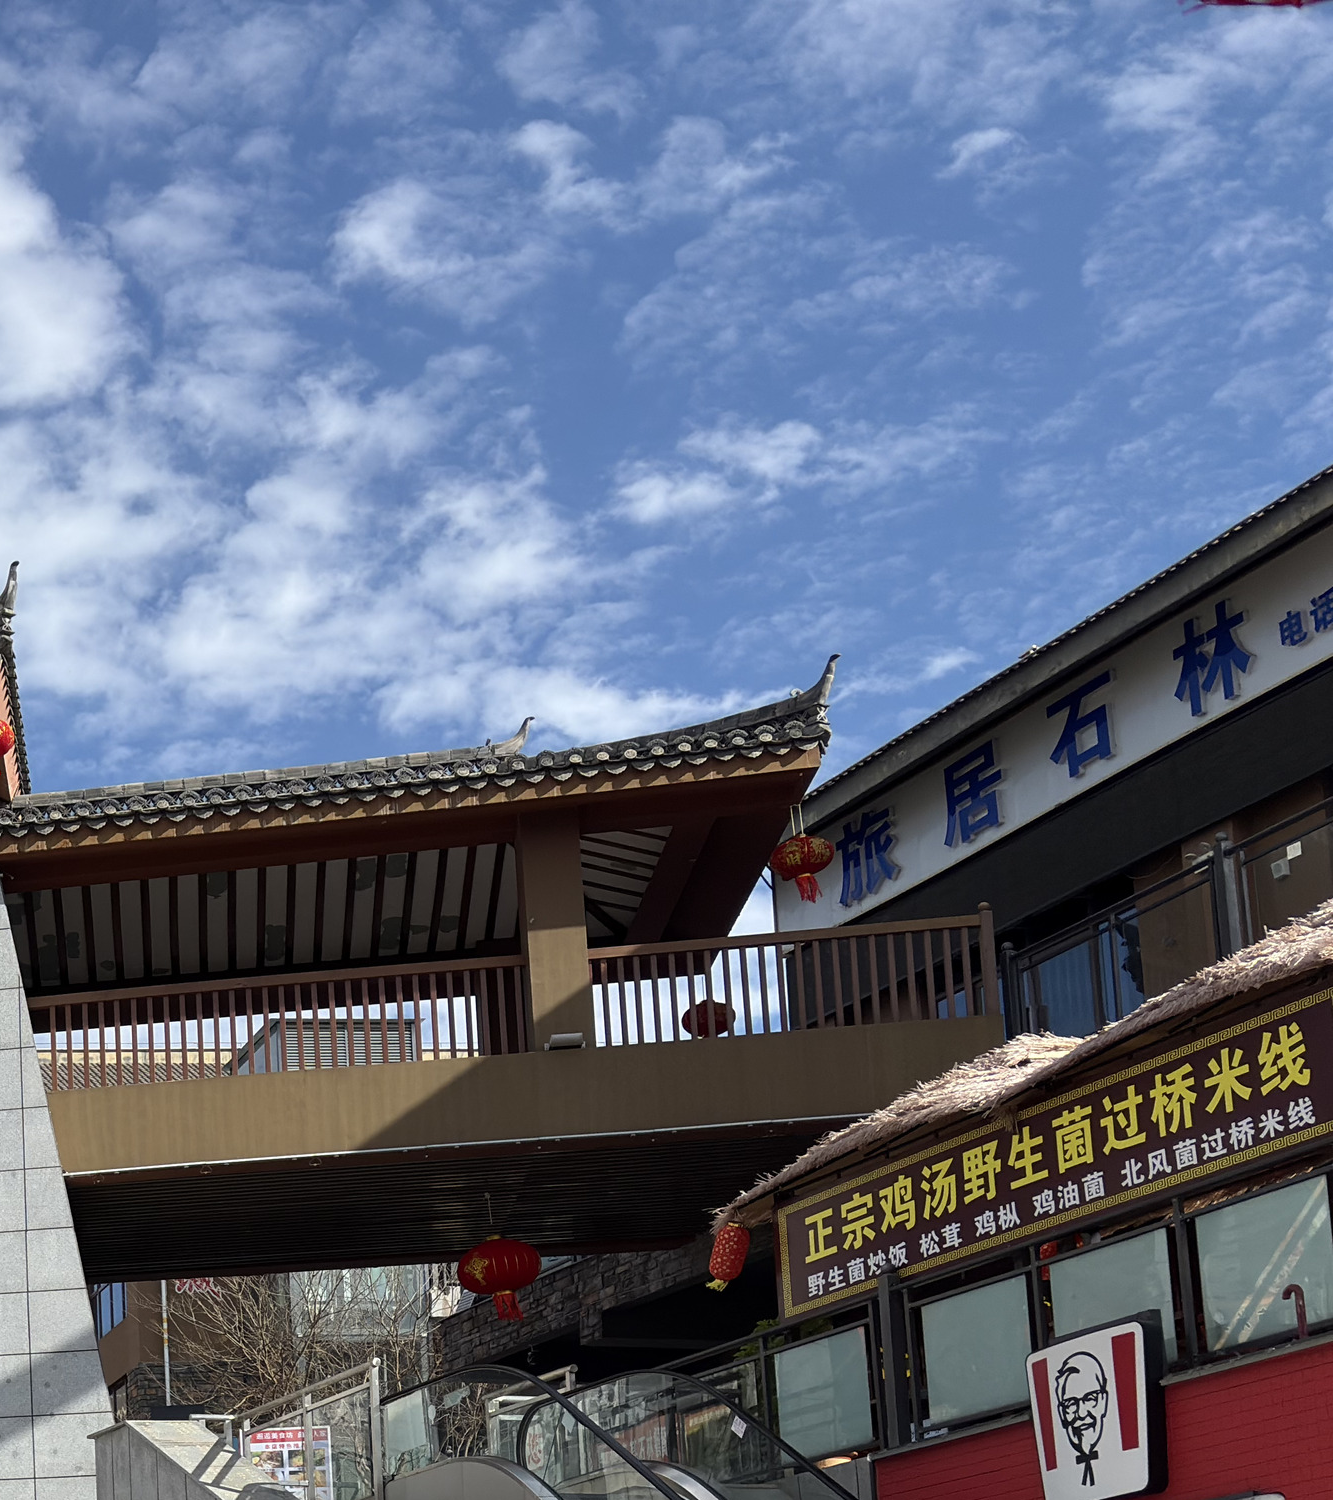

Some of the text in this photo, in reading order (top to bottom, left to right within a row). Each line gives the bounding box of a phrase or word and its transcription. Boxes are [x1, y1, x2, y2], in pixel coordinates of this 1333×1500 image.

[833, 599, 1252, 907] 旅居石林
[804, 1021, 1312, 1264] 正宗鸡汤野生菌过桥米线
[807, 1096, 1317, 1298] 野生菌炒饭 松茸 鸡枞 鸡油菌 北风菌过桥米线
